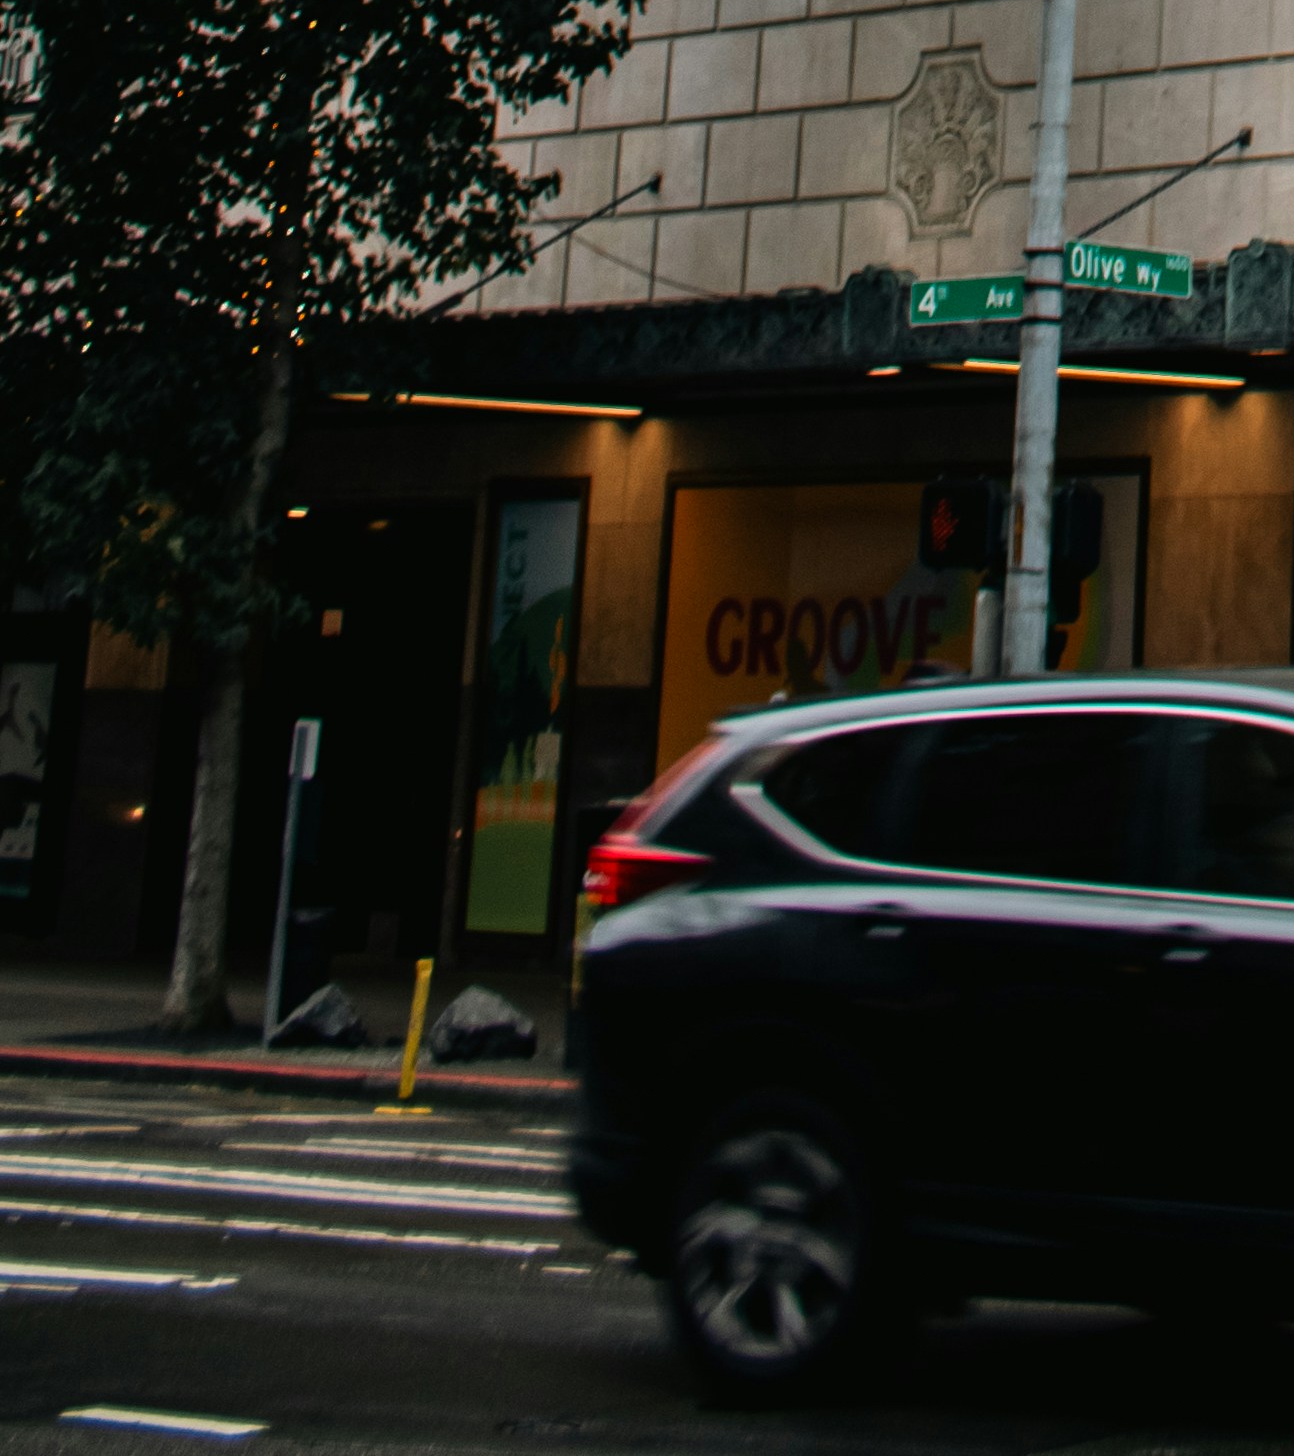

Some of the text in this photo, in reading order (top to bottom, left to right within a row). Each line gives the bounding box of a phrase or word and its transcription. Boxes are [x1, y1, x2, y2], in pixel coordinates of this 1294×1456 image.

[1071, 243, 1126, 283] Olive
[985, 285, 1015, 309] Ave
[706, 595, 948, 675] GROOVE
